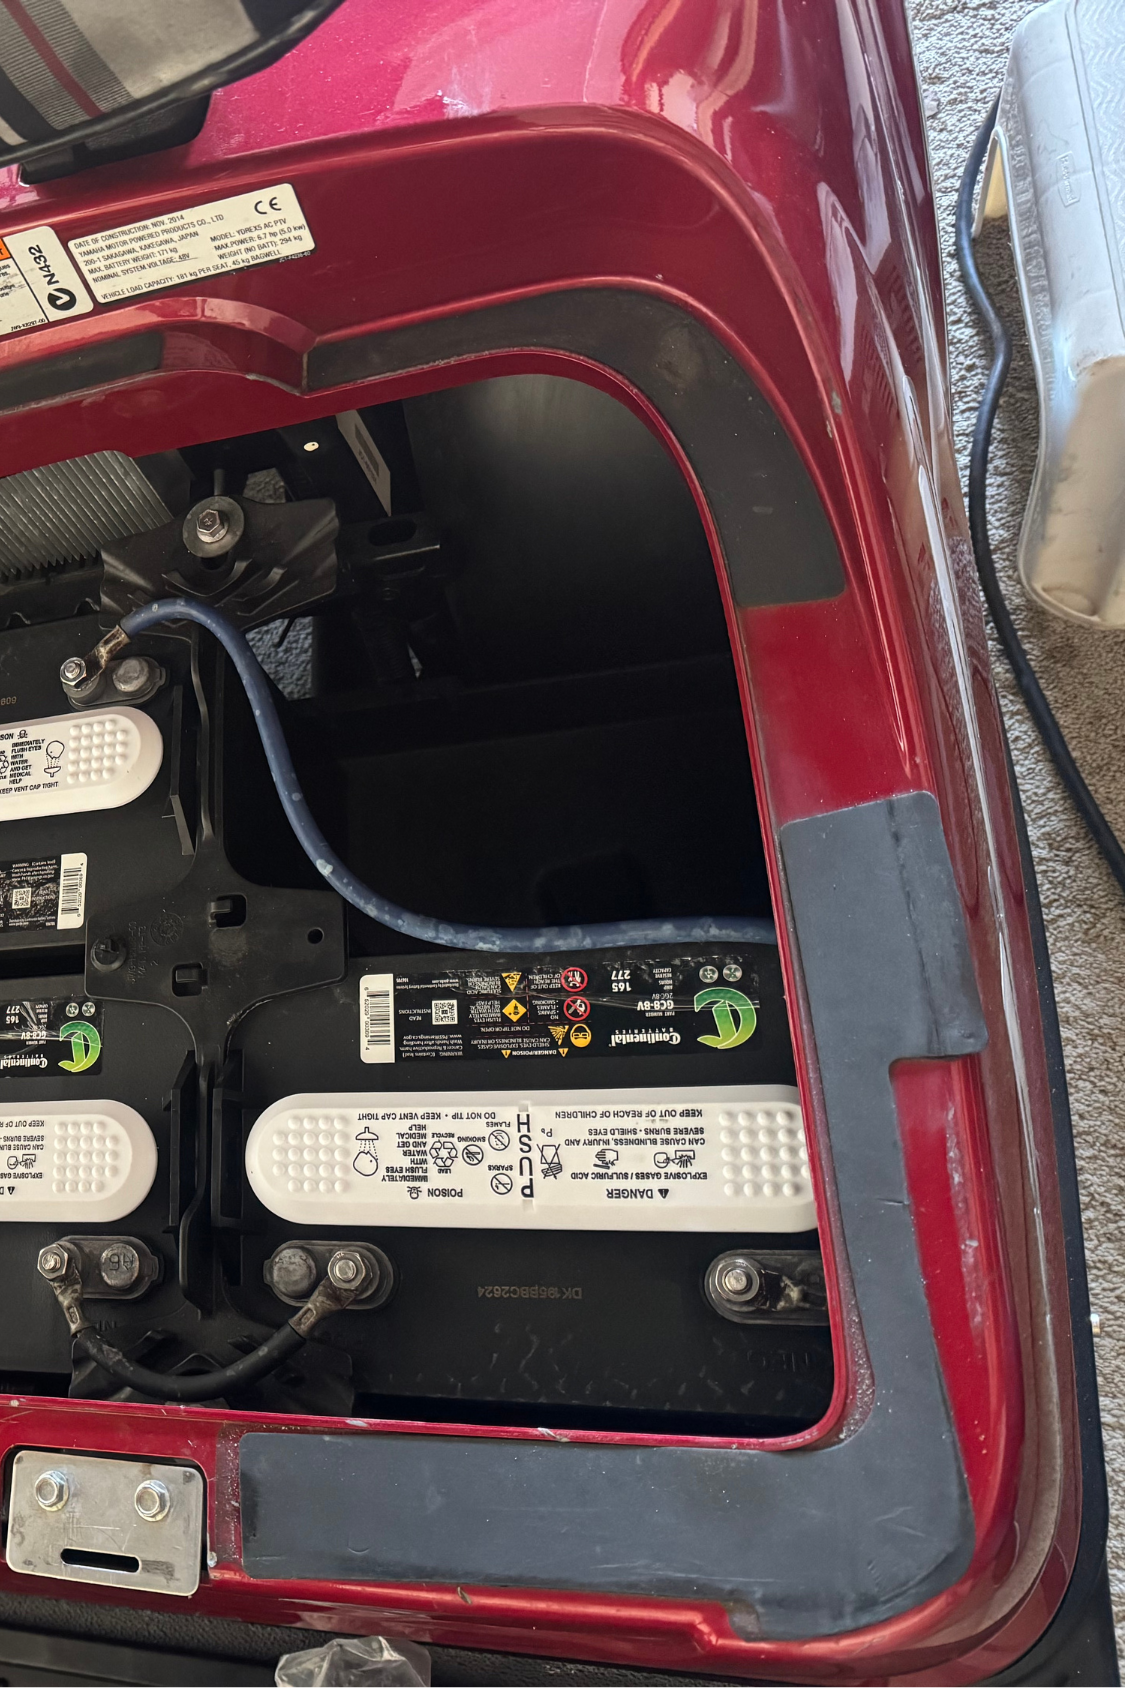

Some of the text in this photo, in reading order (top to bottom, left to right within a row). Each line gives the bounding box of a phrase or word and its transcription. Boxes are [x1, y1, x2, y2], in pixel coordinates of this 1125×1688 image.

[73, 239, 90, 249] DATE
[100, 224, 149, 241] CONSTRUCTION:
[150, 219, 167, 228] NOV.
[167, 214, 184, 223] 2014
[209, 217, 286, 242] MODEL: YDREX5 AC PTV
[78, 214, 224, 257] YAMAHA MOTOR POWERED PRODUCTS CO., LTD
[83, 230, 198, 266] 200-1 SAKAGAWA, KAKEGAWA, JAPAN
[217, 248, 242, 259] WEIGHT
[243, 245, 256, 254] (NO
[256, 240, 278, 250] BATT):
[279, 236, 292, 244] 294
[28, 245, 60, 286] N432
[87, 266, 104, 274] MAX.
[103, 258, 130, 270] BATTERY
[130, 251, 156, 262] WEIGHT:
[157, 248, 168, 256] 171
[92, 252, 189, 282] NOMINAL SYSTEM VOLTAGE: 48V
[101, 288, 125, 299] VEHICLE
[126, 284, 143, 293] LOAD
[143, 276, 173, 288] CAPACITY:
[176, 272, 187, 280] 181
[197, 266, 211, 274] PER
[250, 249, 280, 261] BAGWELL
[610, 969, 630, 979] 277
[611, 981, 631, 992] 165
[6, 1005, 20, 1013] 277
[636, 999, 673, 1010] GC8-8V
[5, 1015, 19, 1023] 165
[610, 1032, 680, 1046] Continental
[0, 1057, 47, 1069] Continental
[357, 1111, 495, 1119] DO NOT TIP KEEP VENT CAP TIGHT
[554, 1109, 702, 1118] KEEP OUT OF REACH OF CHILDREN
[588, 1127, 704, 1135] SEVERE BURNS SHIELD EYES
[564, 1137, 705, 1145] CAN CAUSE BLINDNESS, INJURY AND
[516, 1112, 533, 1197] PUSH
[487, 1163, 513, 1171] SPARKS
[570, 1171, 707, 1179] EXPLOSIVE GASES SULFURIC ACID
[427, 1187, 462, 1197] POISON
[606, 1187, 653, 1198] DANGER
